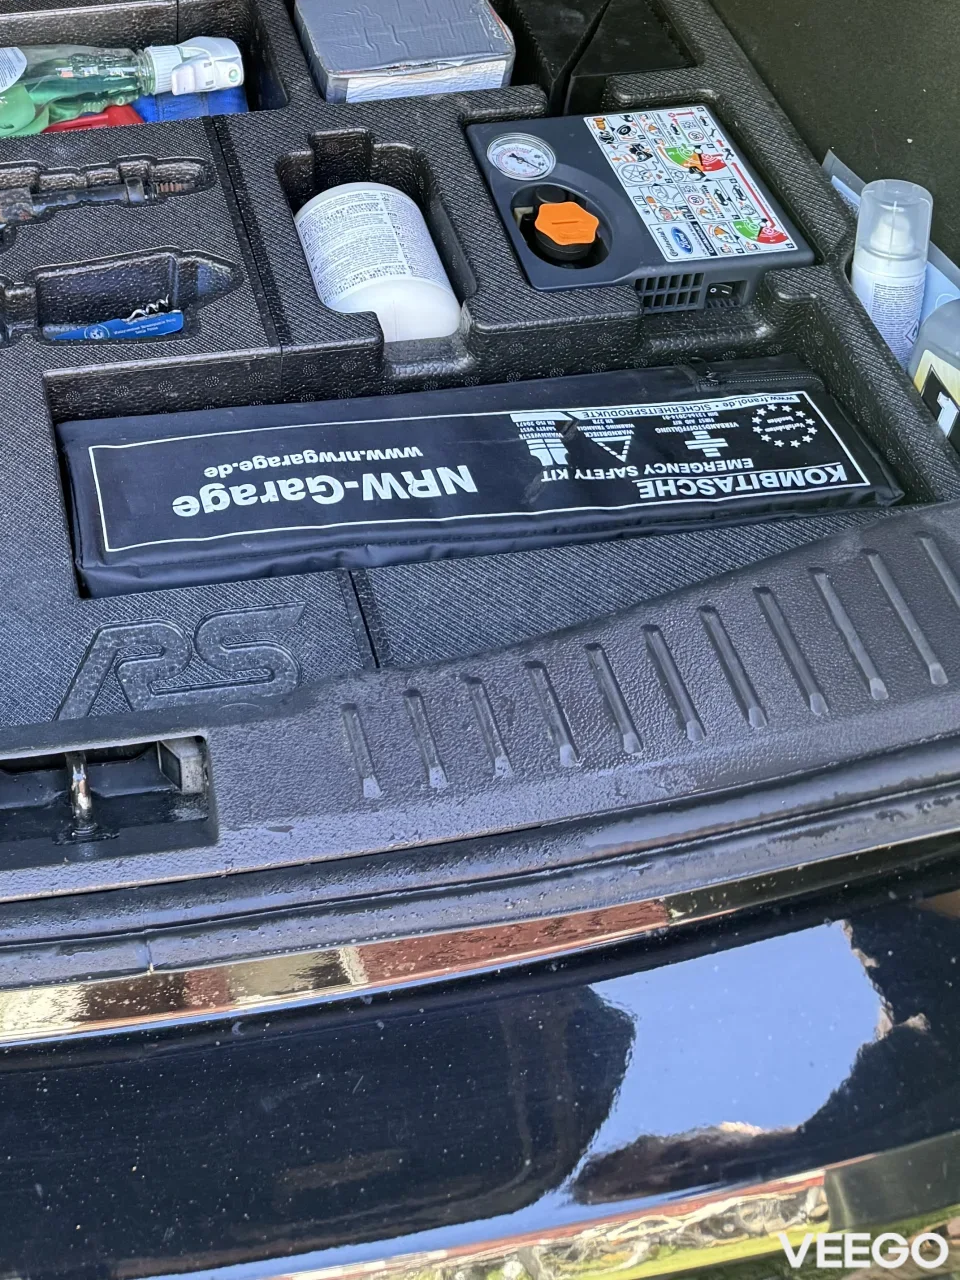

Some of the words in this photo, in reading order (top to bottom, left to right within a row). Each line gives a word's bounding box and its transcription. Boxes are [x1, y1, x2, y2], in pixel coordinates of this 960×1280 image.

[582, 403, 712, 418] SICHERHEITSPRODUKTE
[722, 395, 796, 409] www.franol.de
[203, 446, 424, 478] www.nrwgarage.de
[644, 458, 754, 475] EMERGENCY
[541, 469, 569, 483] KIT
[574, 465, 639, 480] SAFETY
[637, 464, 848, 498] KOMBITASCHE
[172, 465, 479, 518] NRW-Garage
[51, 601, 306, 721] RS
